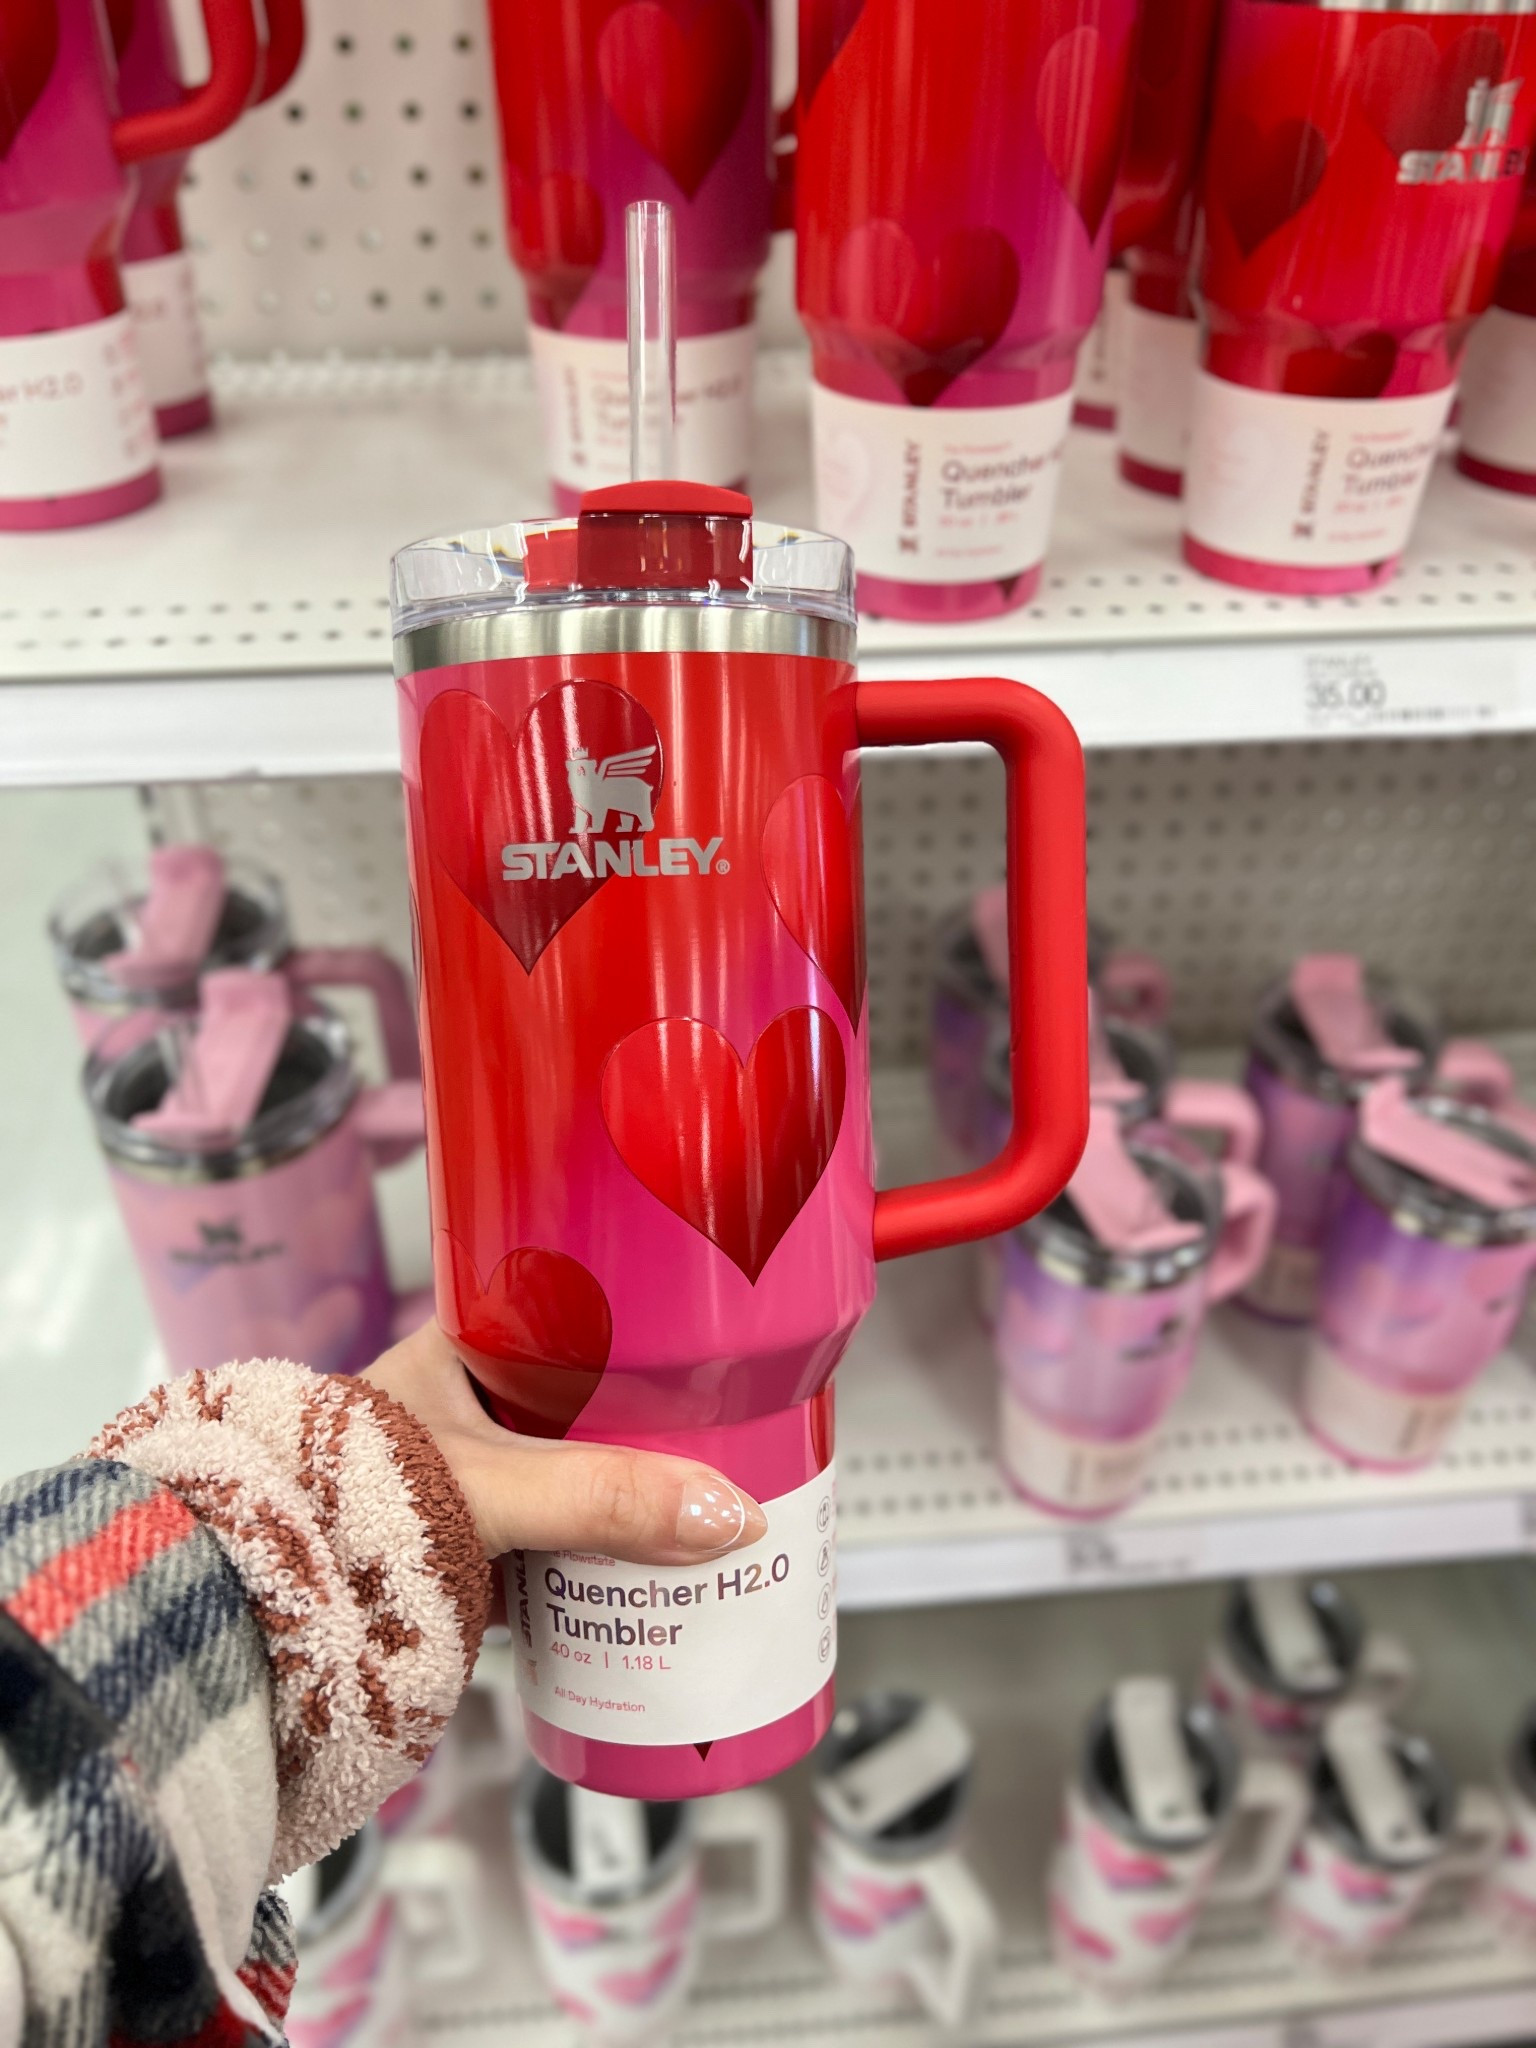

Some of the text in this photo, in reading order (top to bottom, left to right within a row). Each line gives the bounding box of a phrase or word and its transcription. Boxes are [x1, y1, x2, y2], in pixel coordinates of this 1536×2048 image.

[563, 1550, 616, 1567] Flowstate
[514, 1548, 533, 1648] STANLE
[545, 1553, 790, 1608] Quencher H2.0
[546, 1602, 683, 1646] Tumbler
[551, 1641, 570, 1658] 40
[574, 1651, 592, 1664] oz
[622, 1655, 653, 1670] 1.18
[659, 1656, 671, 1670] L
[555, 1686, 646, 1713] All Day Hydration
